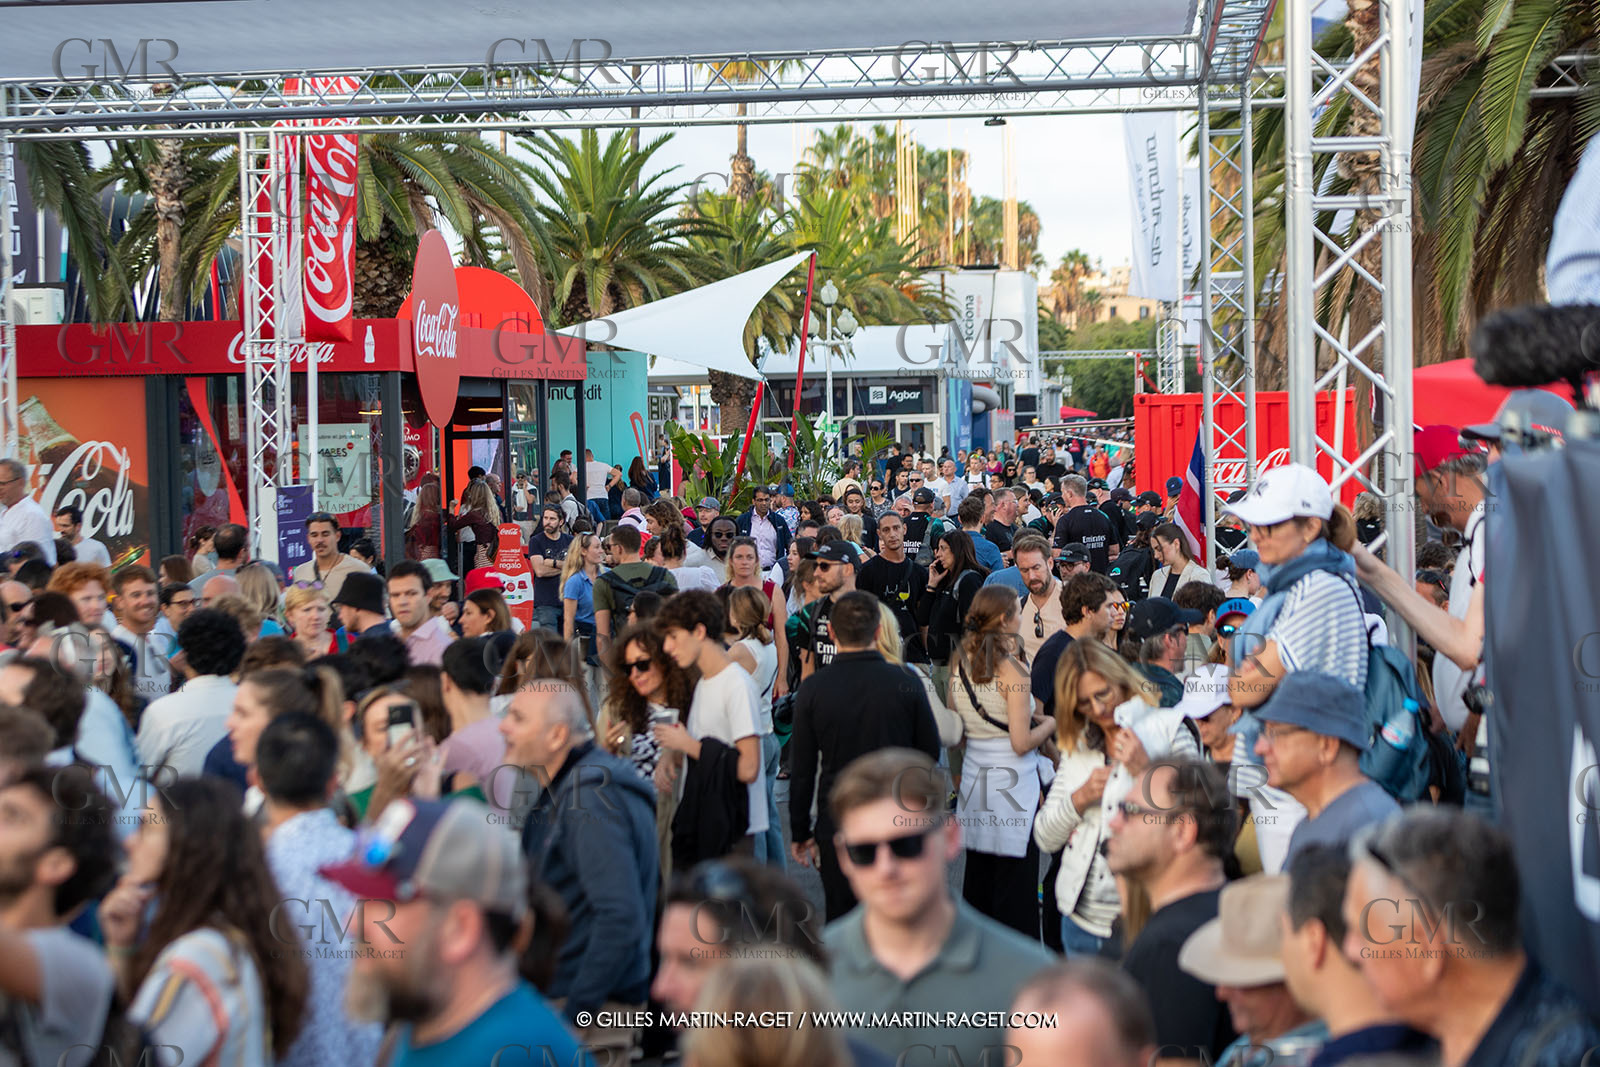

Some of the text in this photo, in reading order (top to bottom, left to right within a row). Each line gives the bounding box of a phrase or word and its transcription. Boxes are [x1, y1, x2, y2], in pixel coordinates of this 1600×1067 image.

[415, 299, 459, 359] Coca-Cola
[888, 390, 921, 402] Agbar
[903, 540, 921, 548] mirate
[499, 562, 521, 570] regalo
